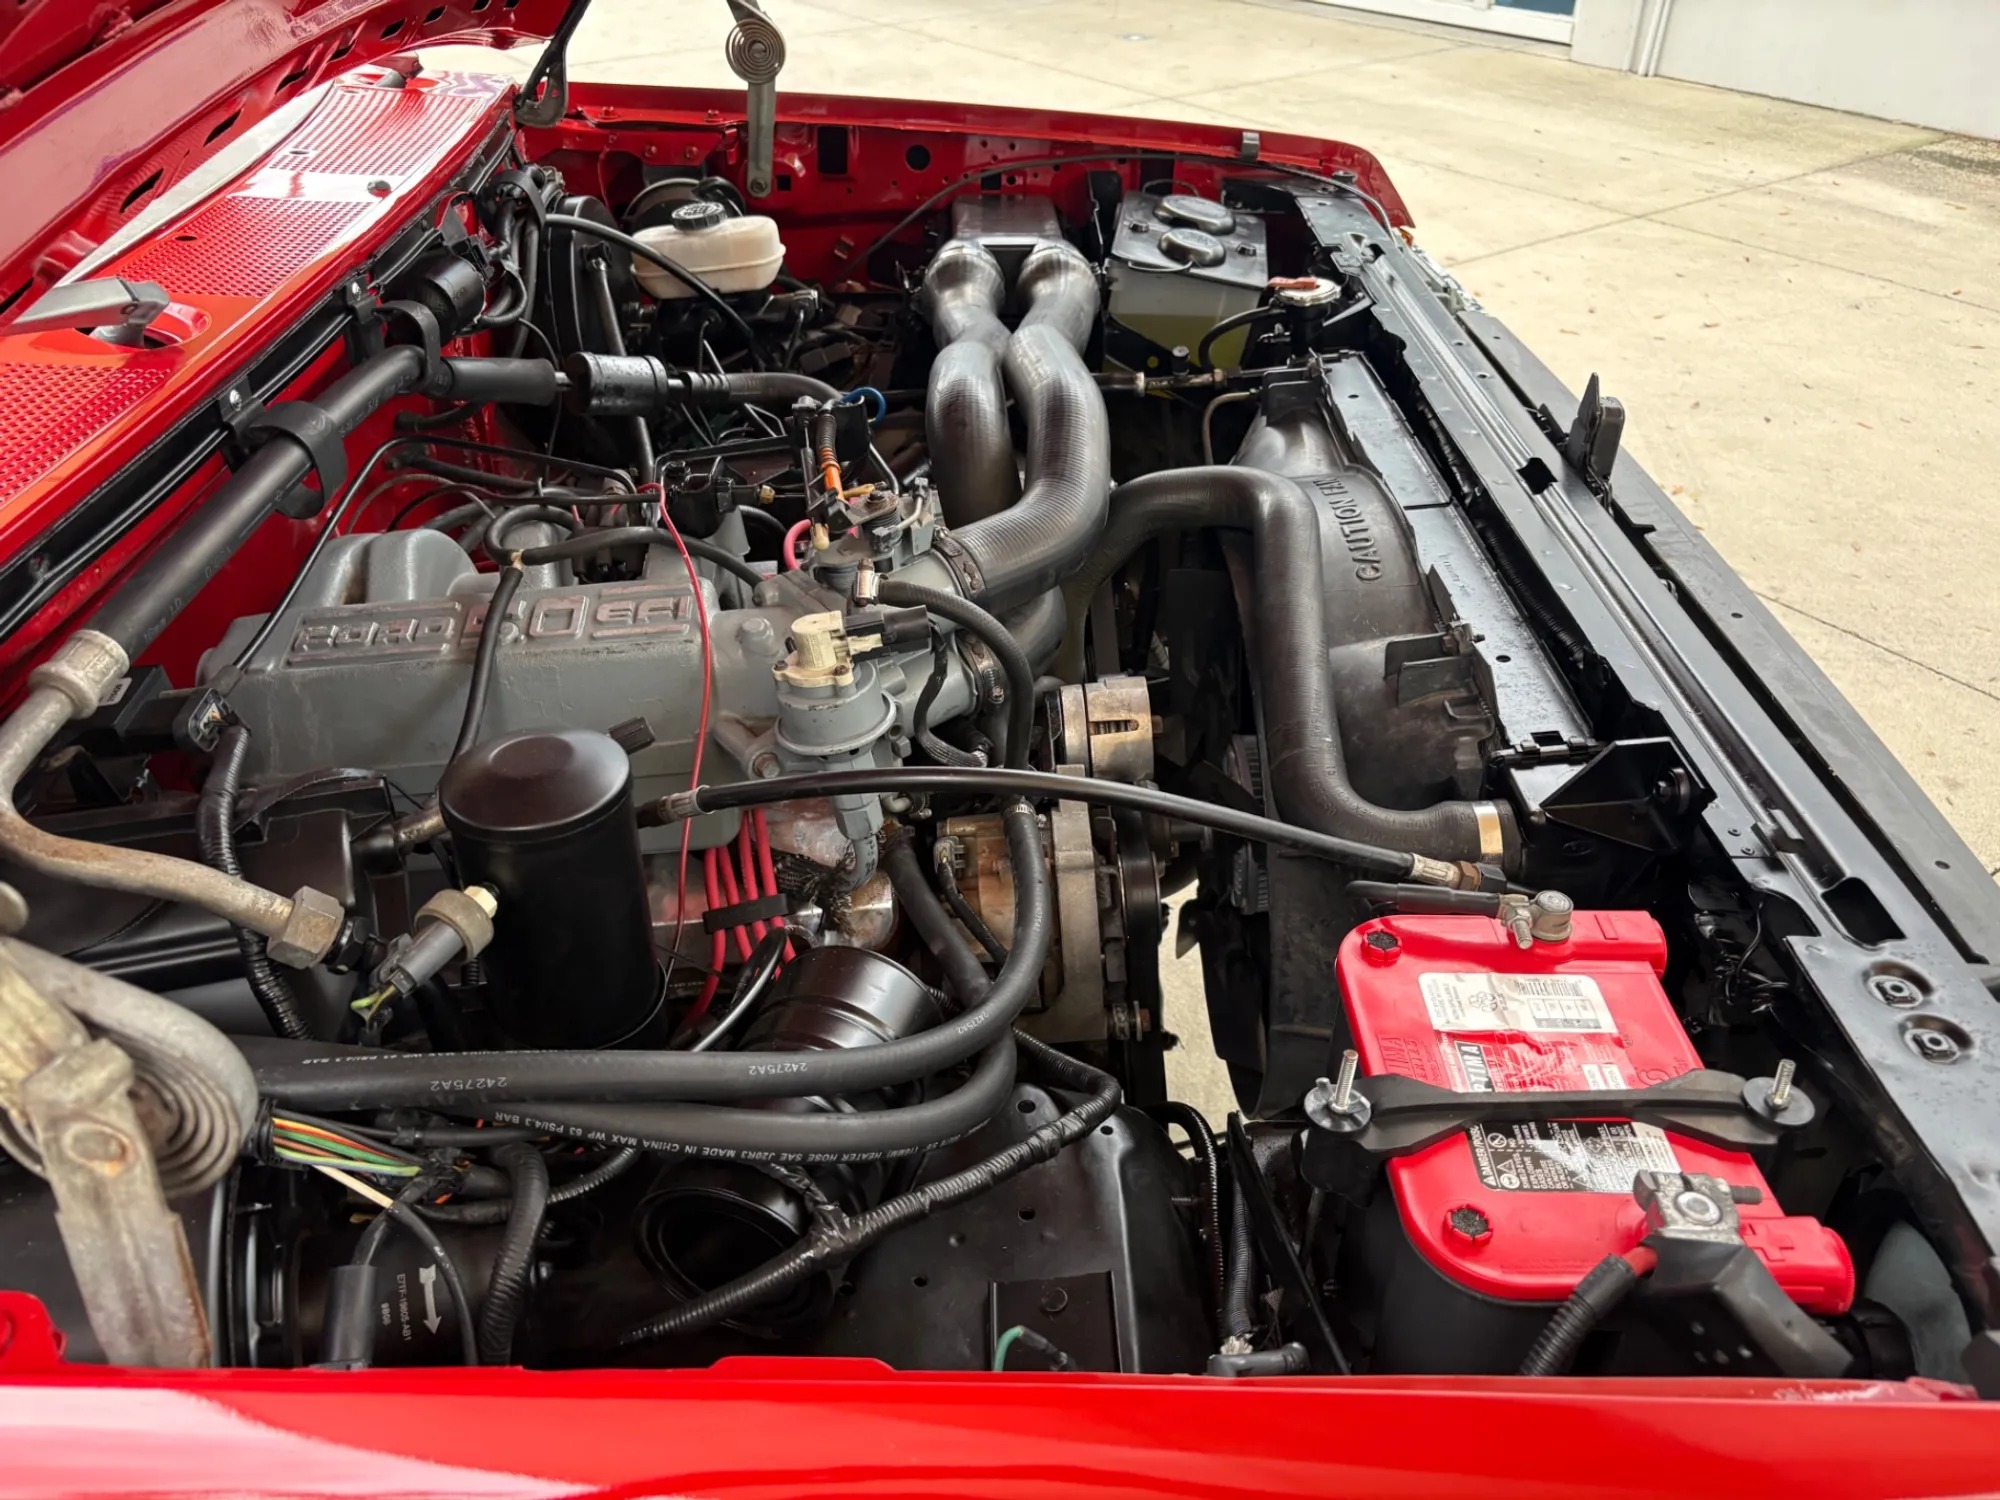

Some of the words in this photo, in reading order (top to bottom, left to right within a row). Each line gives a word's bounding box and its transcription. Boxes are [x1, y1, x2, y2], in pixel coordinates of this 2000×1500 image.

[1313, 478, 1348, 497] FAN
[1328, 495, 1383, 581] CAUTION
[294, 615, 455, 653] FORD
[594, 594, 692, 626] EFI
[748, 1062, 807, 1075] 24275A2
[1461, 1046, 1492, 1091] PTIMA
[429, 1077, 507, 1091] 24275A2
[493, 1111, 520, 1125] BAR
[524, 1117, 564, 1134] PSI/4.3
[568, 1125, 583, 1137] 63
[587, 1130, 606, 1142] WP
[611, 1133, 638, 1147] MAX
[1508, 1137, 1517, 1147] NO
[642, 1138, 680, 1152] CHINA
[684, 1144, 698, 1155] IN
[701, 1147, 736, 1158] MADE
[741, 1150, 776, 1161] J20R3
[780, 1152, 802, 1162] SAE
[807, 1152, 838, 1163] HOSE
[841, 1152, 882, 1163] HEATER
[1513, 1152, 1524, 1167] EYES
[1518, 1168, 1531, 1188] SHIELD
[1523, 1156, 1541, 1188] EXPLOSIVE
[1535, 1168, 1548, 1188] GASES
